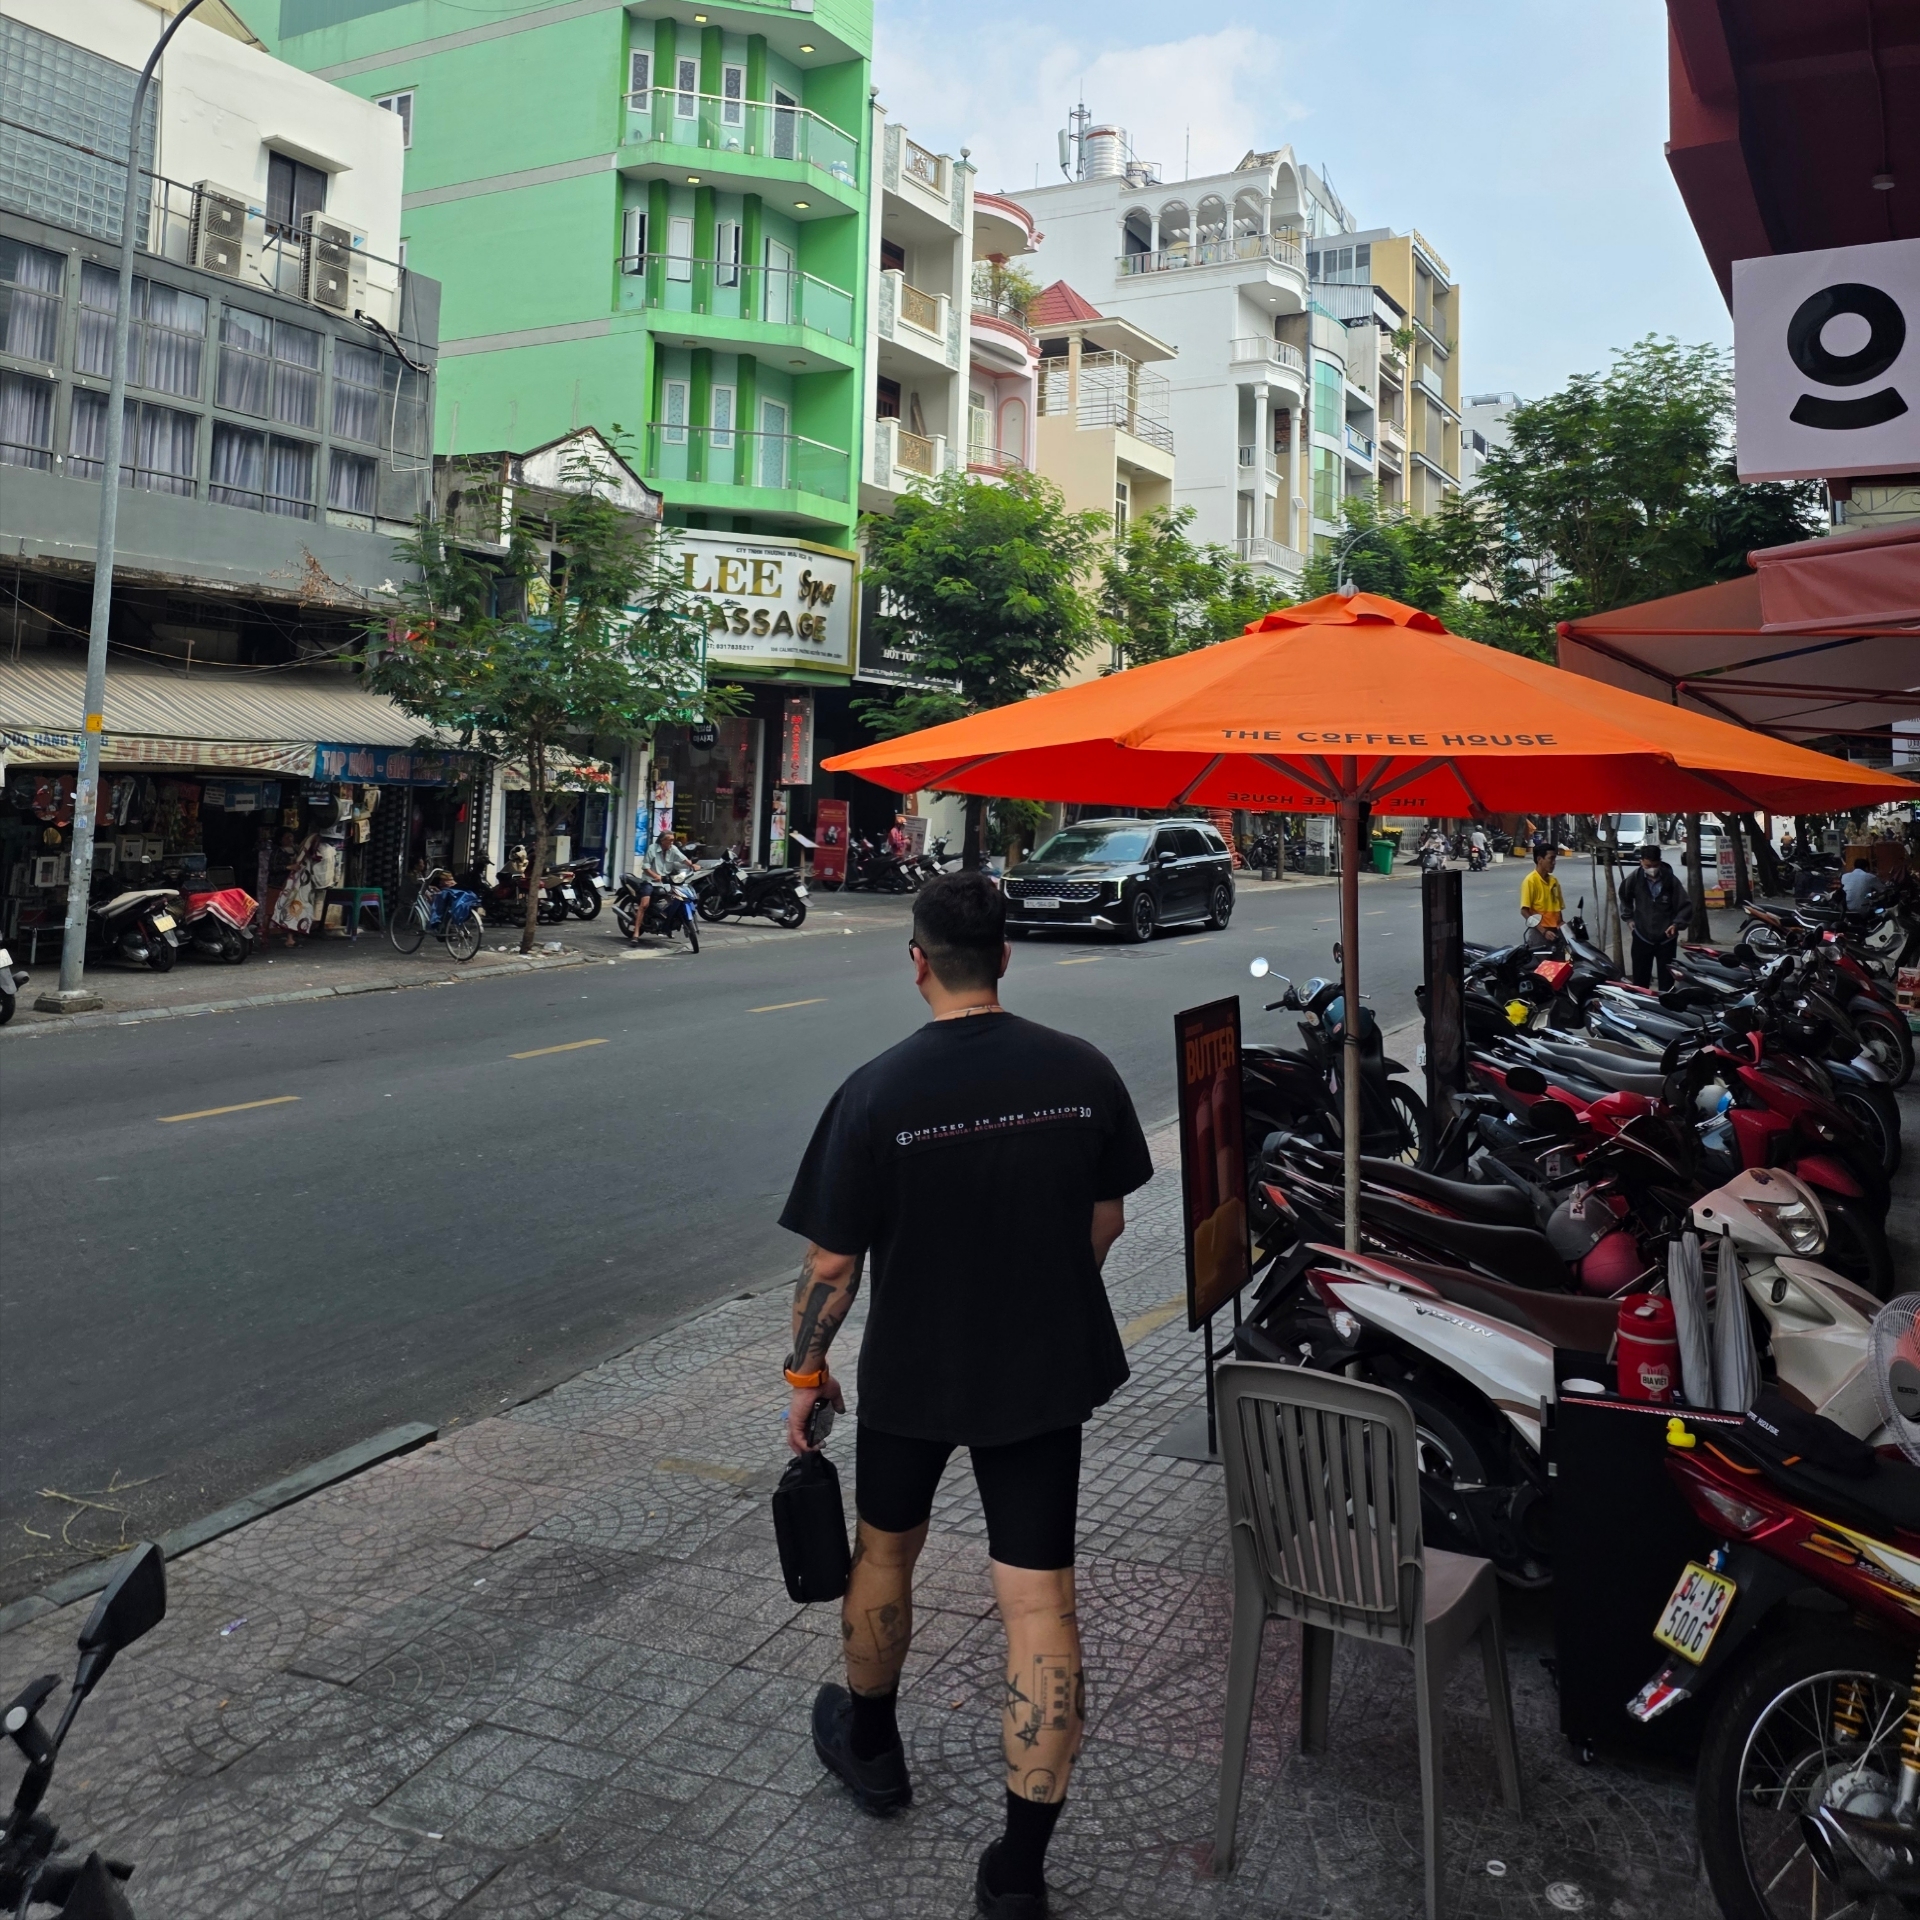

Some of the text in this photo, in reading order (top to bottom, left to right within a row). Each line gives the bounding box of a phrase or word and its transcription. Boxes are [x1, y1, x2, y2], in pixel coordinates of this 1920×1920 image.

[680, 553, 783, 598] LEE
[798, 569, 837, 609] Spa
[679, 604, 827, 643] ASSAGE
[115, 739, 200, 763] MINH
[1221, 729, 1558, 746] THE COFFEE HOUSE
[348, 748, 375, 777] HÓA
[1186, 1026, 1236, 1085] BUTTER
[914, 1122, 965, 1136] UNITED
[975, 1118, 990, 1126] IN
[999, 1113, 1025, 1123] NEW
[1033, 1106, 1078, 1118] VISION
[1642, 1375, 1654, 1385] BIA
[1663, 1605, 1708, 1653] 5006
